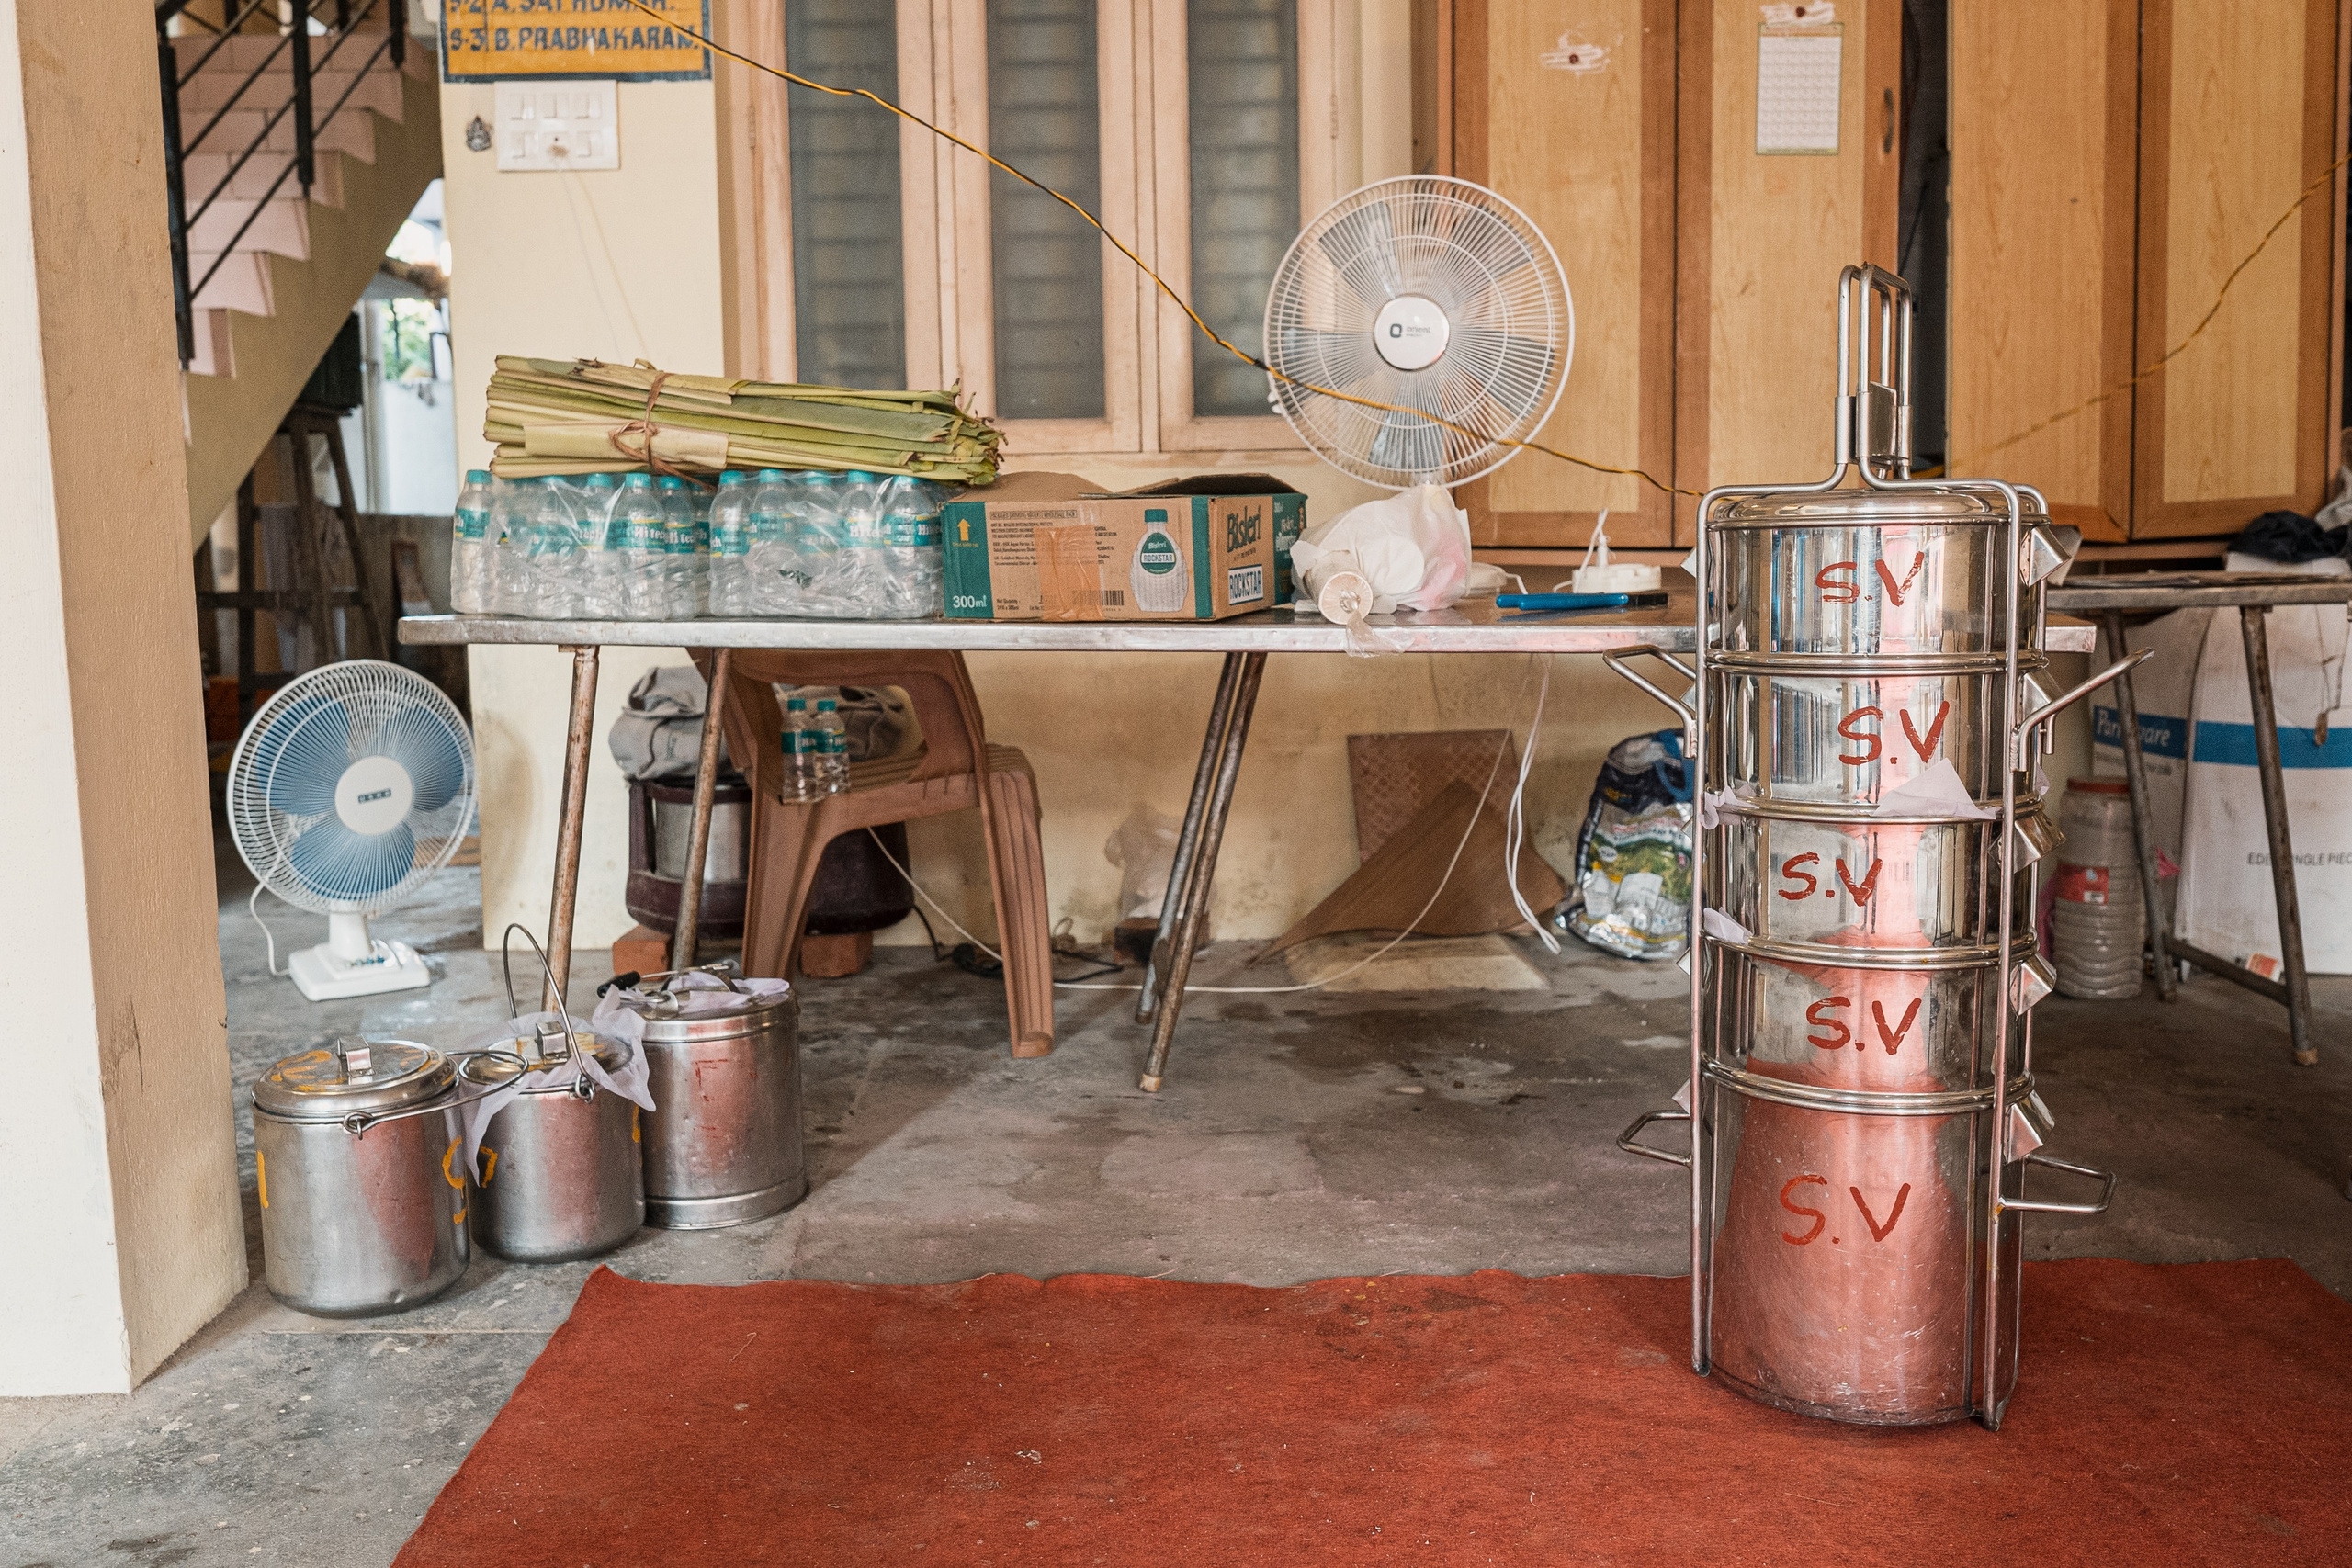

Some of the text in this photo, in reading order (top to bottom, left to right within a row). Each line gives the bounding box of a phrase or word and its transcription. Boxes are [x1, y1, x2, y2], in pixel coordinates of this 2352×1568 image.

[1227, 504, 1261, 553] Bisleri
[1143, 554, 1173, 562] ROCKSTAR
[1229, 570, 1262, 600] ROCKSTAR
[1815, 551, 1924, 607] S.V
[953, 594, 987, 609] 300ml
[1838, 701, 1950, 766] S.V
[1778, 852, 1883, 907] S.V
[1806, 996, 1922, 1055] S.V
[1780, 1174, 1911, 1246] S.V
